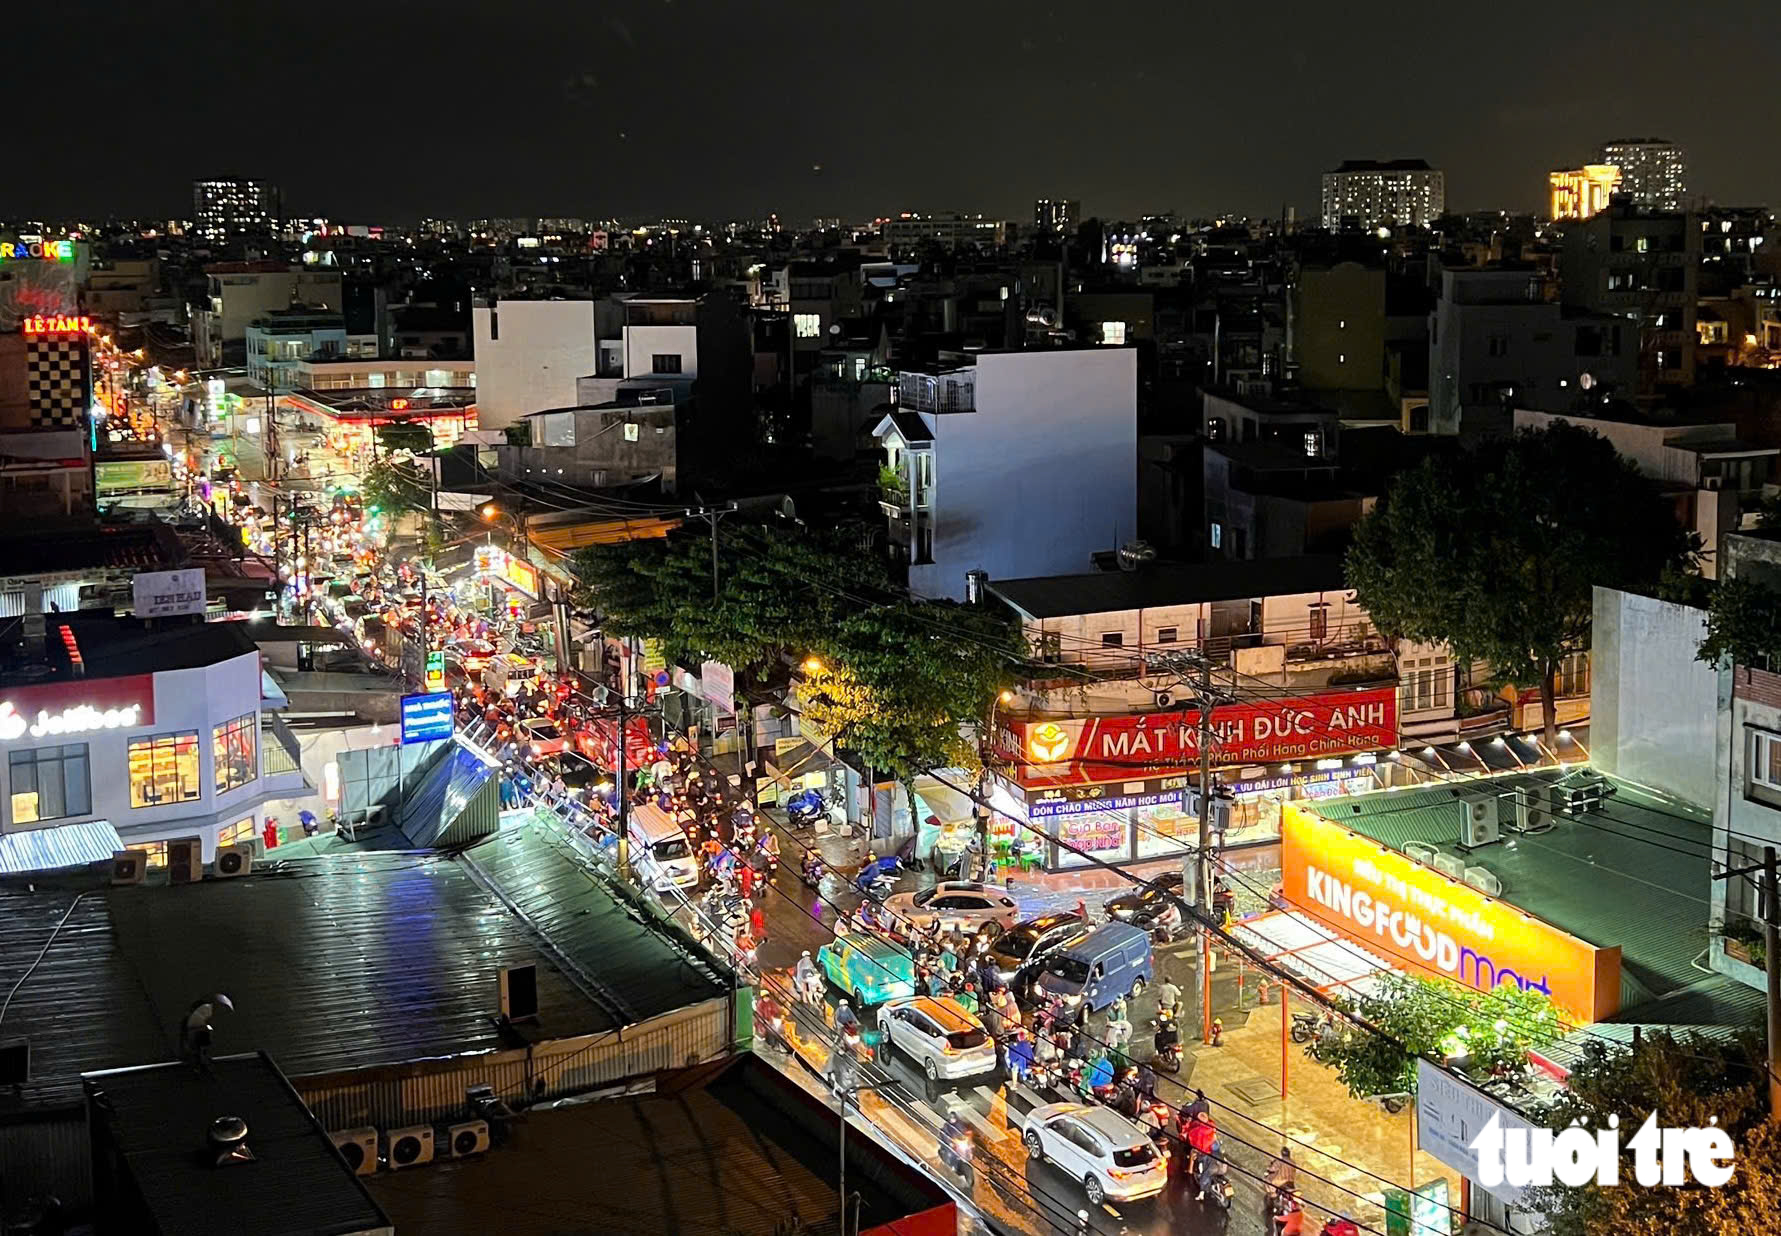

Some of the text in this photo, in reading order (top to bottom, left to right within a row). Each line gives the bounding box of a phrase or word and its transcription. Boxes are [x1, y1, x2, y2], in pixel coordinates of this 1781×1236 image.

[1102, 716, 1167, 757] MẮT
[1254, 708, 1315, 741] ĐỨC
[1328, 703, 1384, 731] ANH
[1242, 743, 1270, 760] Phối
[1056, 801, 1081, 814] CHÀO
[1115, 797, 1136, 808] NĂM
[1138, 795, 1157, 806] HỌC
[1307, 866, 1459, 973] KINGFOOD
